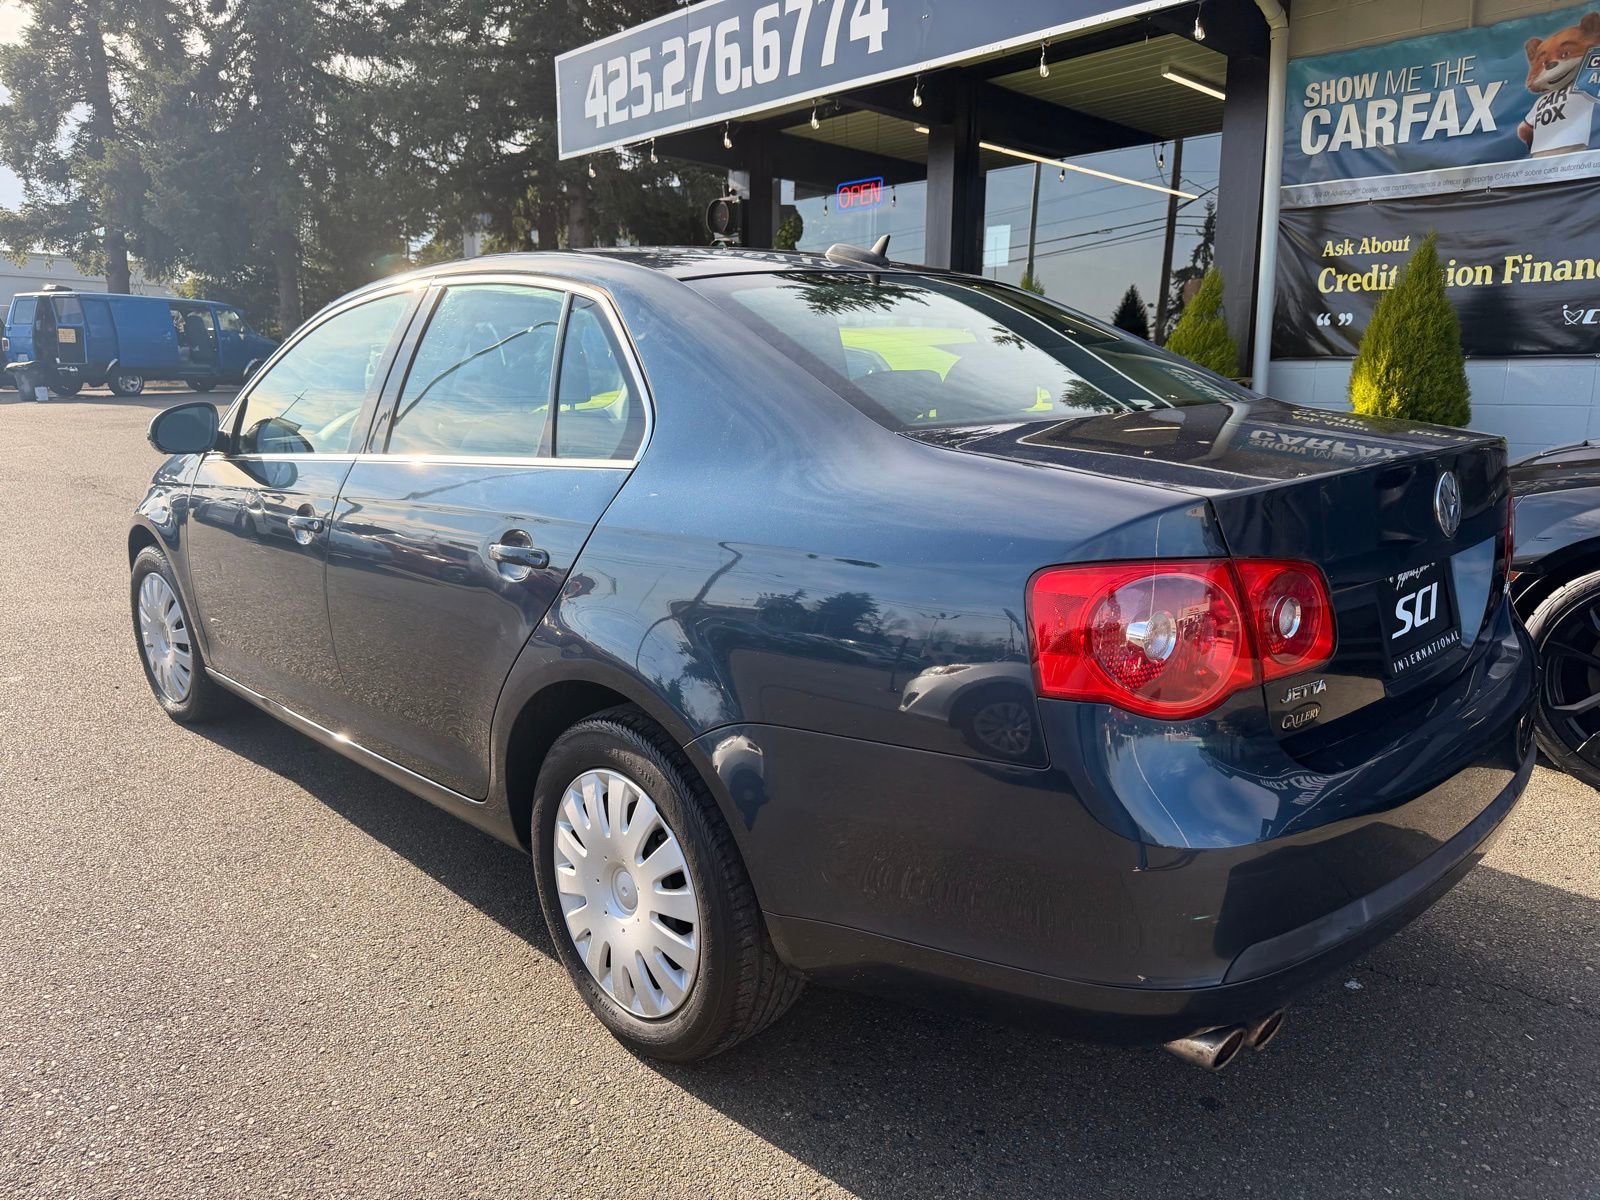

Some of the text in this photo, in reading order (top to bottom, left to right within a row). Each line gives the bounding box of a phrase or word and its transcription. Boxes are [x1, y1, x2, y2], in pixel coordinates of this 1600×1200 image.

[584, 0, 889, 129] 425.276.6774
[1303, 55, 1477, 108] SHOW ME THE
[1537, 89, 1568, 111] CAR
[1535, 103, 1566, 129] FOX
[838, 181, 881, 209] OPEN
[1321, 235, 1411, 258] Ask About
[1317, 263, 1398, 295] Credit
[1391, 581, 1438, 640] SCI
[1393, 630, 1460, 673] INTERNATIONAL
[1280, 679, 1327, 704] JETTA
